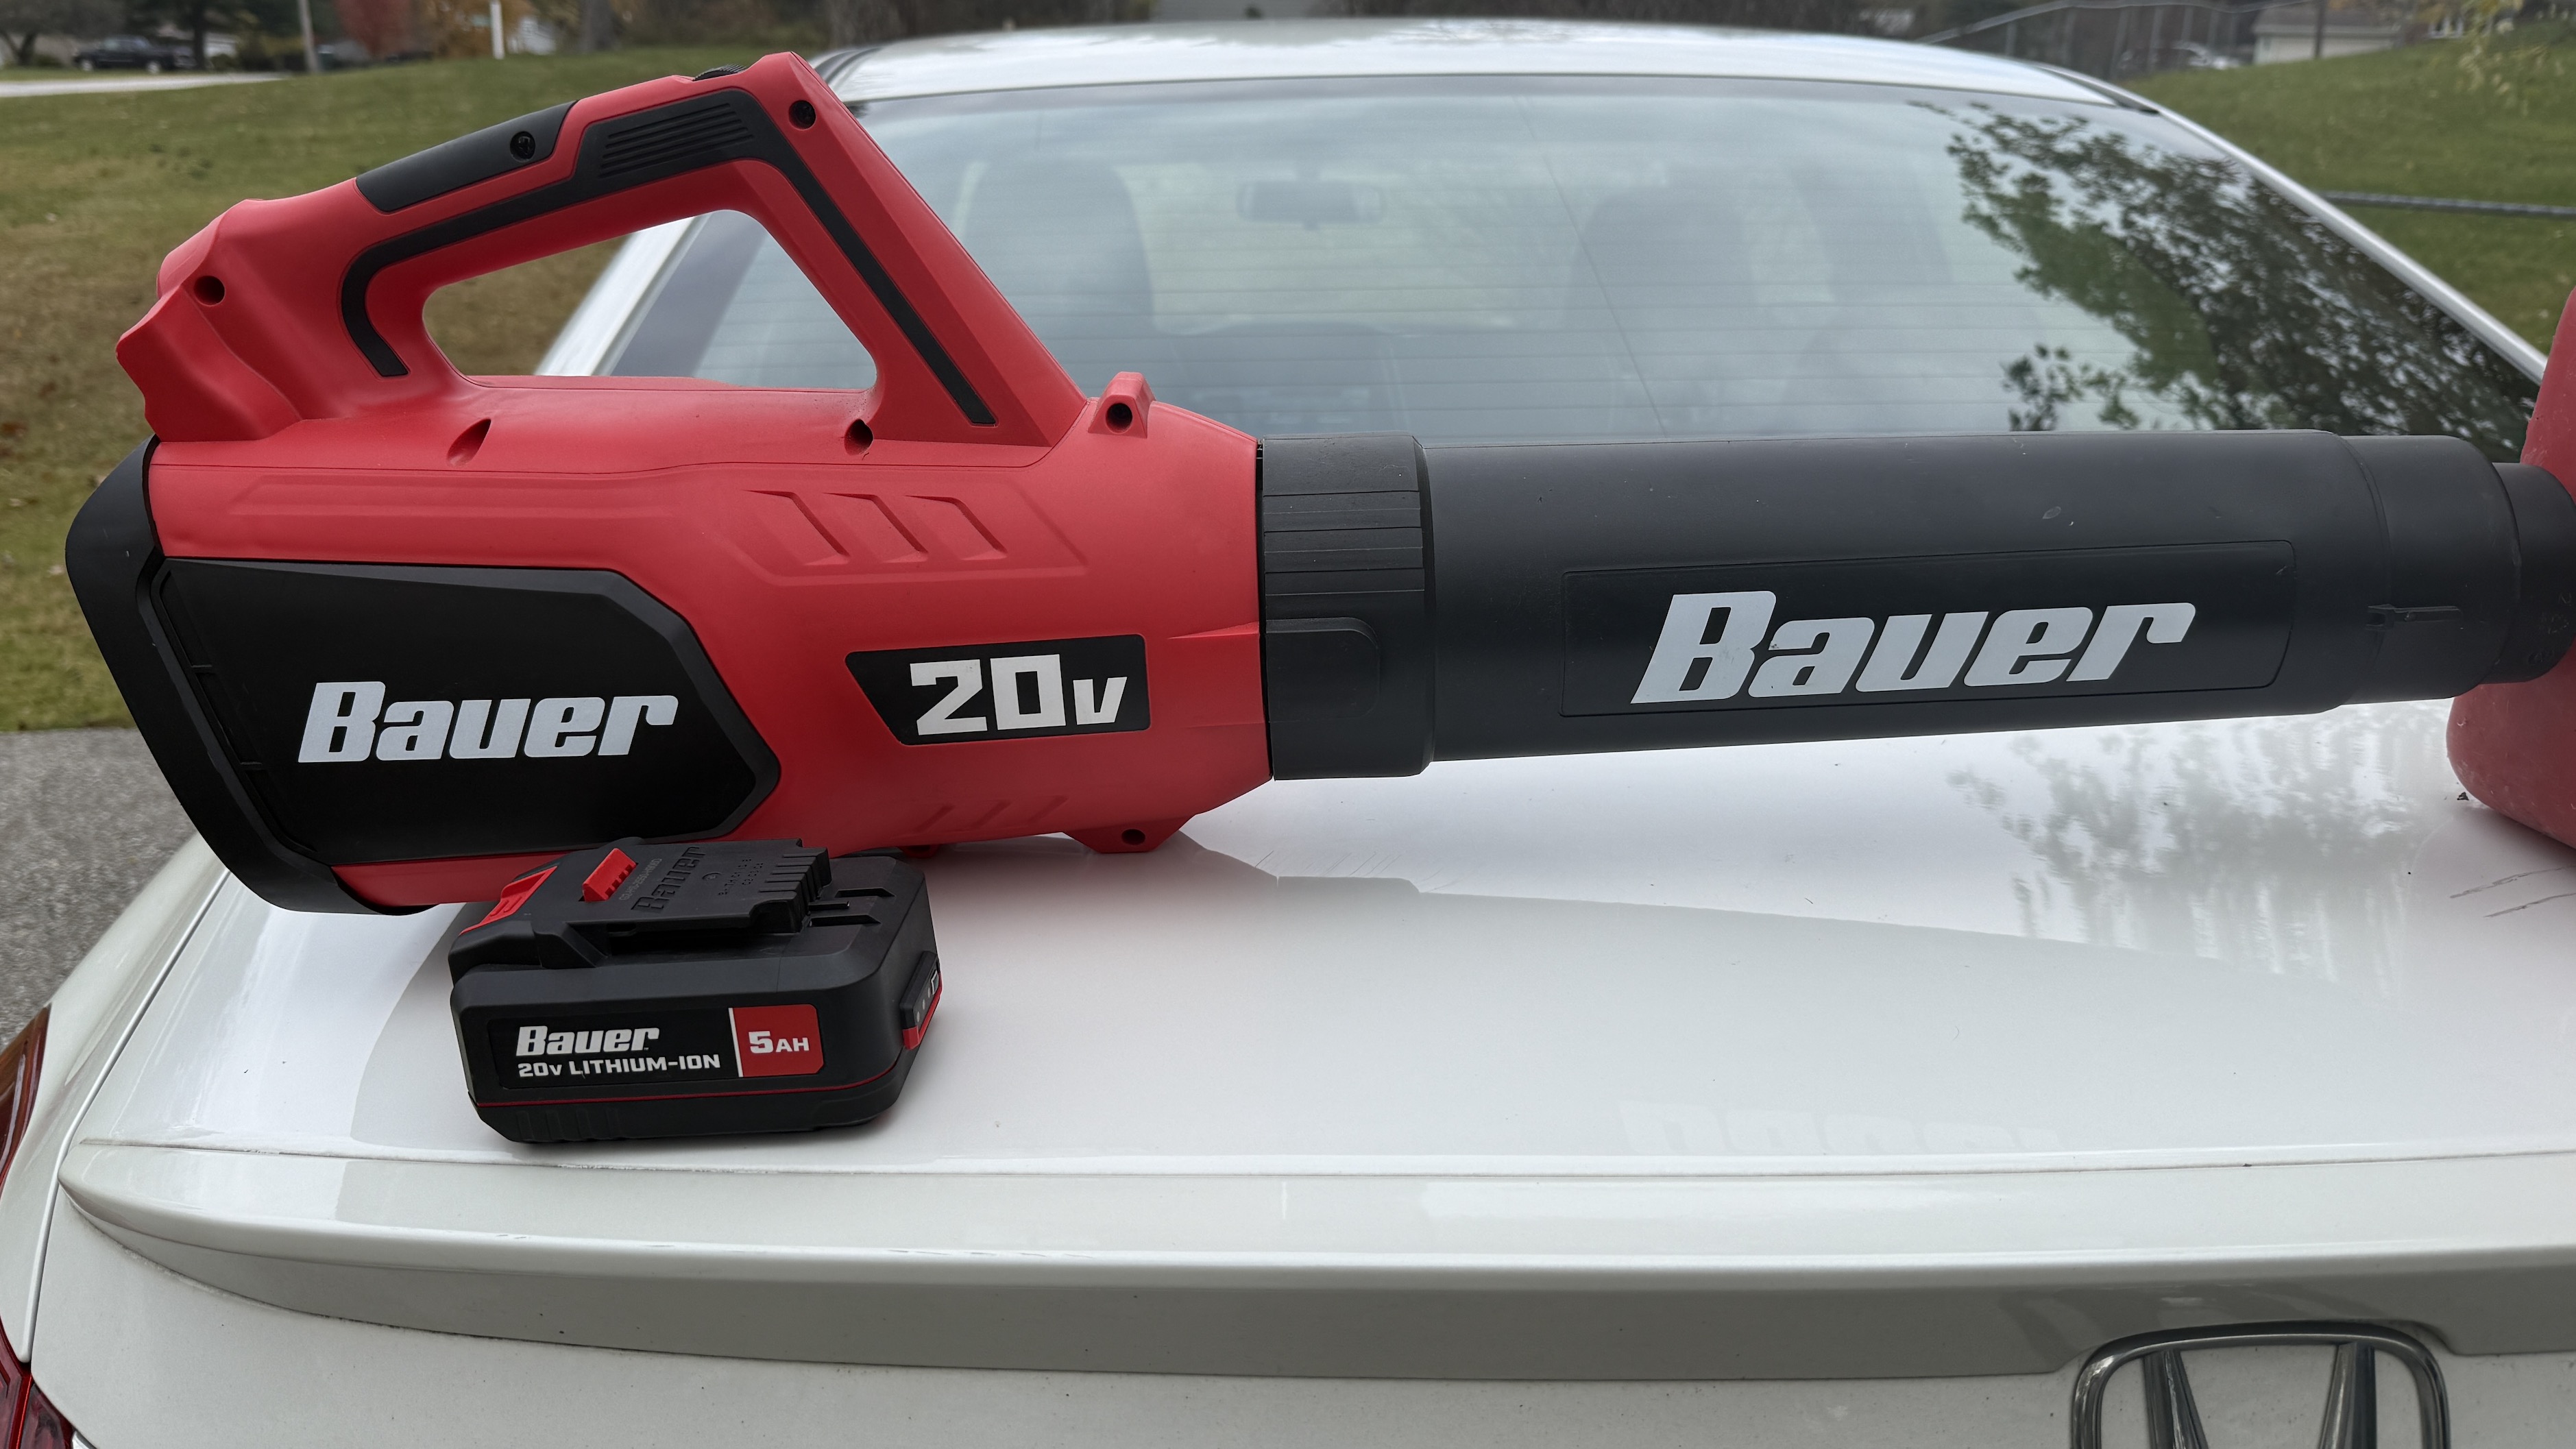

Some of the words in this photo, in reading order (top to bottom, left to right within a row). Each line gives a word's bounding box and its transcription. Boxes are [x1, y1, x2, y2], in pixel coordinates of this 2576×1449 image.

[1630, 590, 2196, 704] Bauer
[298, 681, 679, 763] Bauer
[631, 847, 706, 913] Bauer
[515, 1025, 660, 1057] Bauer
[569, 1054, 721, 1077] LITHIUM-ION
